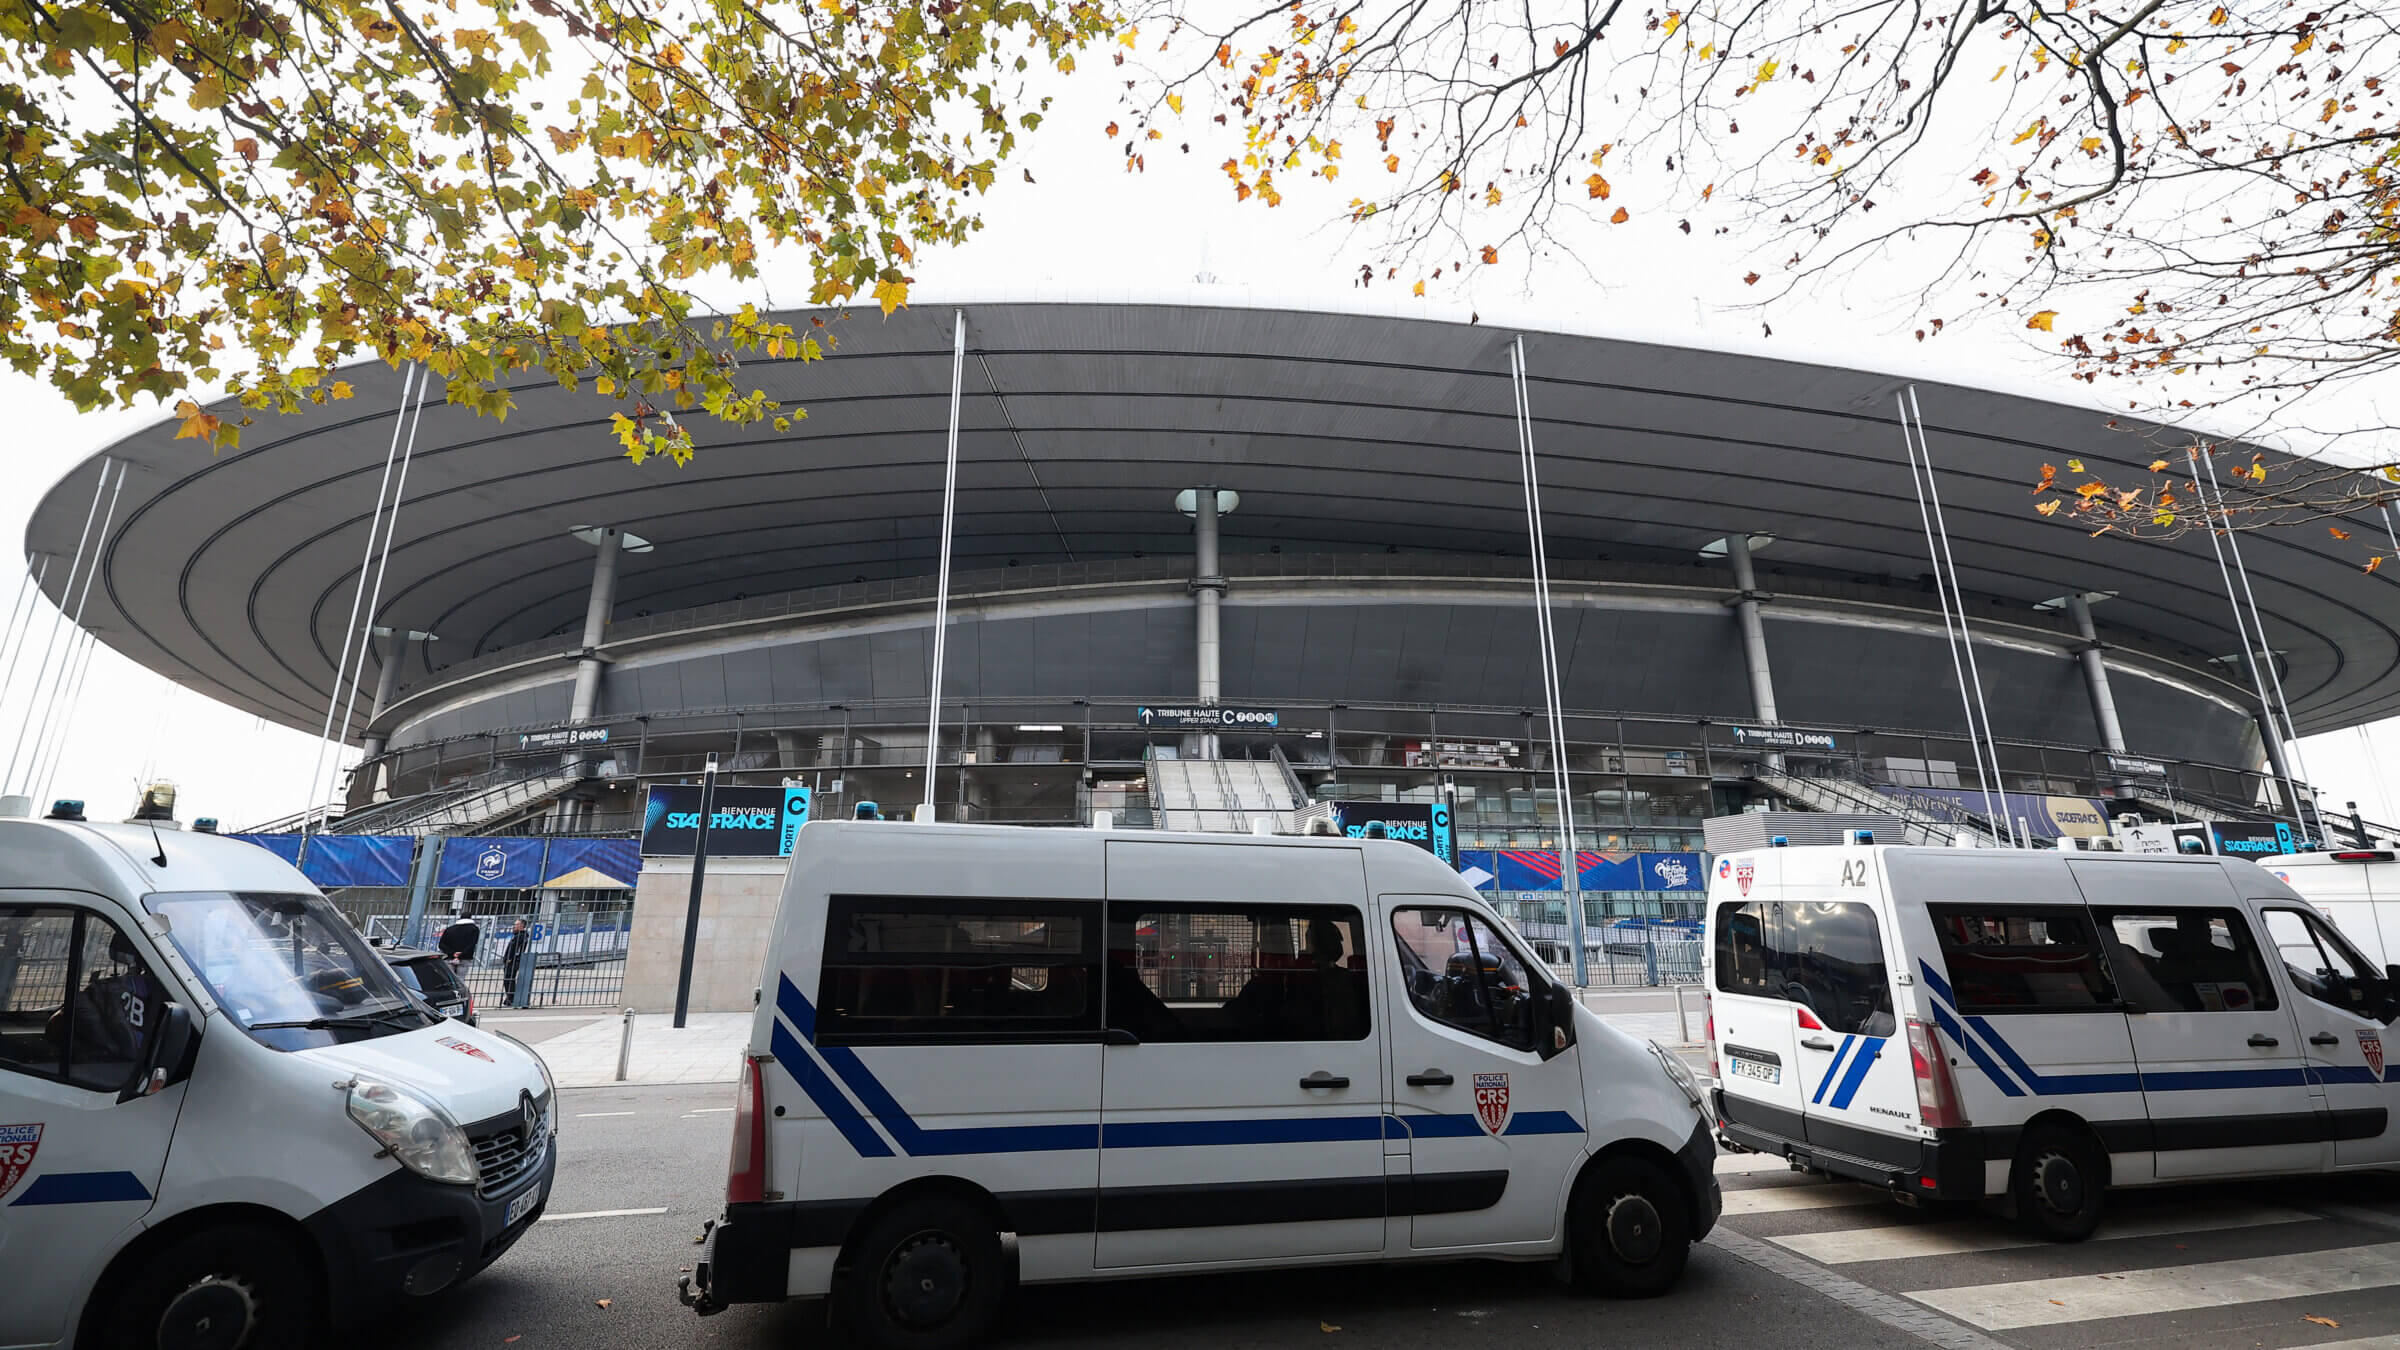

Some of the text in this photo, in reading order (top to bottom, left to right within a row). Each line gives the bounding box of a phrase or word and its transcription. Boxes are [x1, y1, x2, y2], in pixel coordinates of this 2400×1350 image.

[1157, 709, 1191, 717] TRIBUNE
[1194, 709, 1220, 718] HAUTE
[1223, 710, 1235, 724] C
[569, 730, 578, 743] B
[1795, 733, 1804, 745] D
[721, 807, 776, 815] BIENVENUE
[788, 796, 806, 815] C
[1435, 811, 1448, 827] C
[784, 824, 795, 853] PORTE
[2279, 828, 2289, 842] D
[1737, 868, 1753, 879] CRS
[1841, 859, 1866, 887] A2
[2361, 1041, 2380, 1053] CRS
[1477, 1089, 1508, 1105] CRS
[1870, 1106, 1912, 1119] RENAULT
[0, 1126, 36, 1135] OLICE
[0, 1134, 38, 1142] IONALE
[0, 1144, 33, 1166] RS
